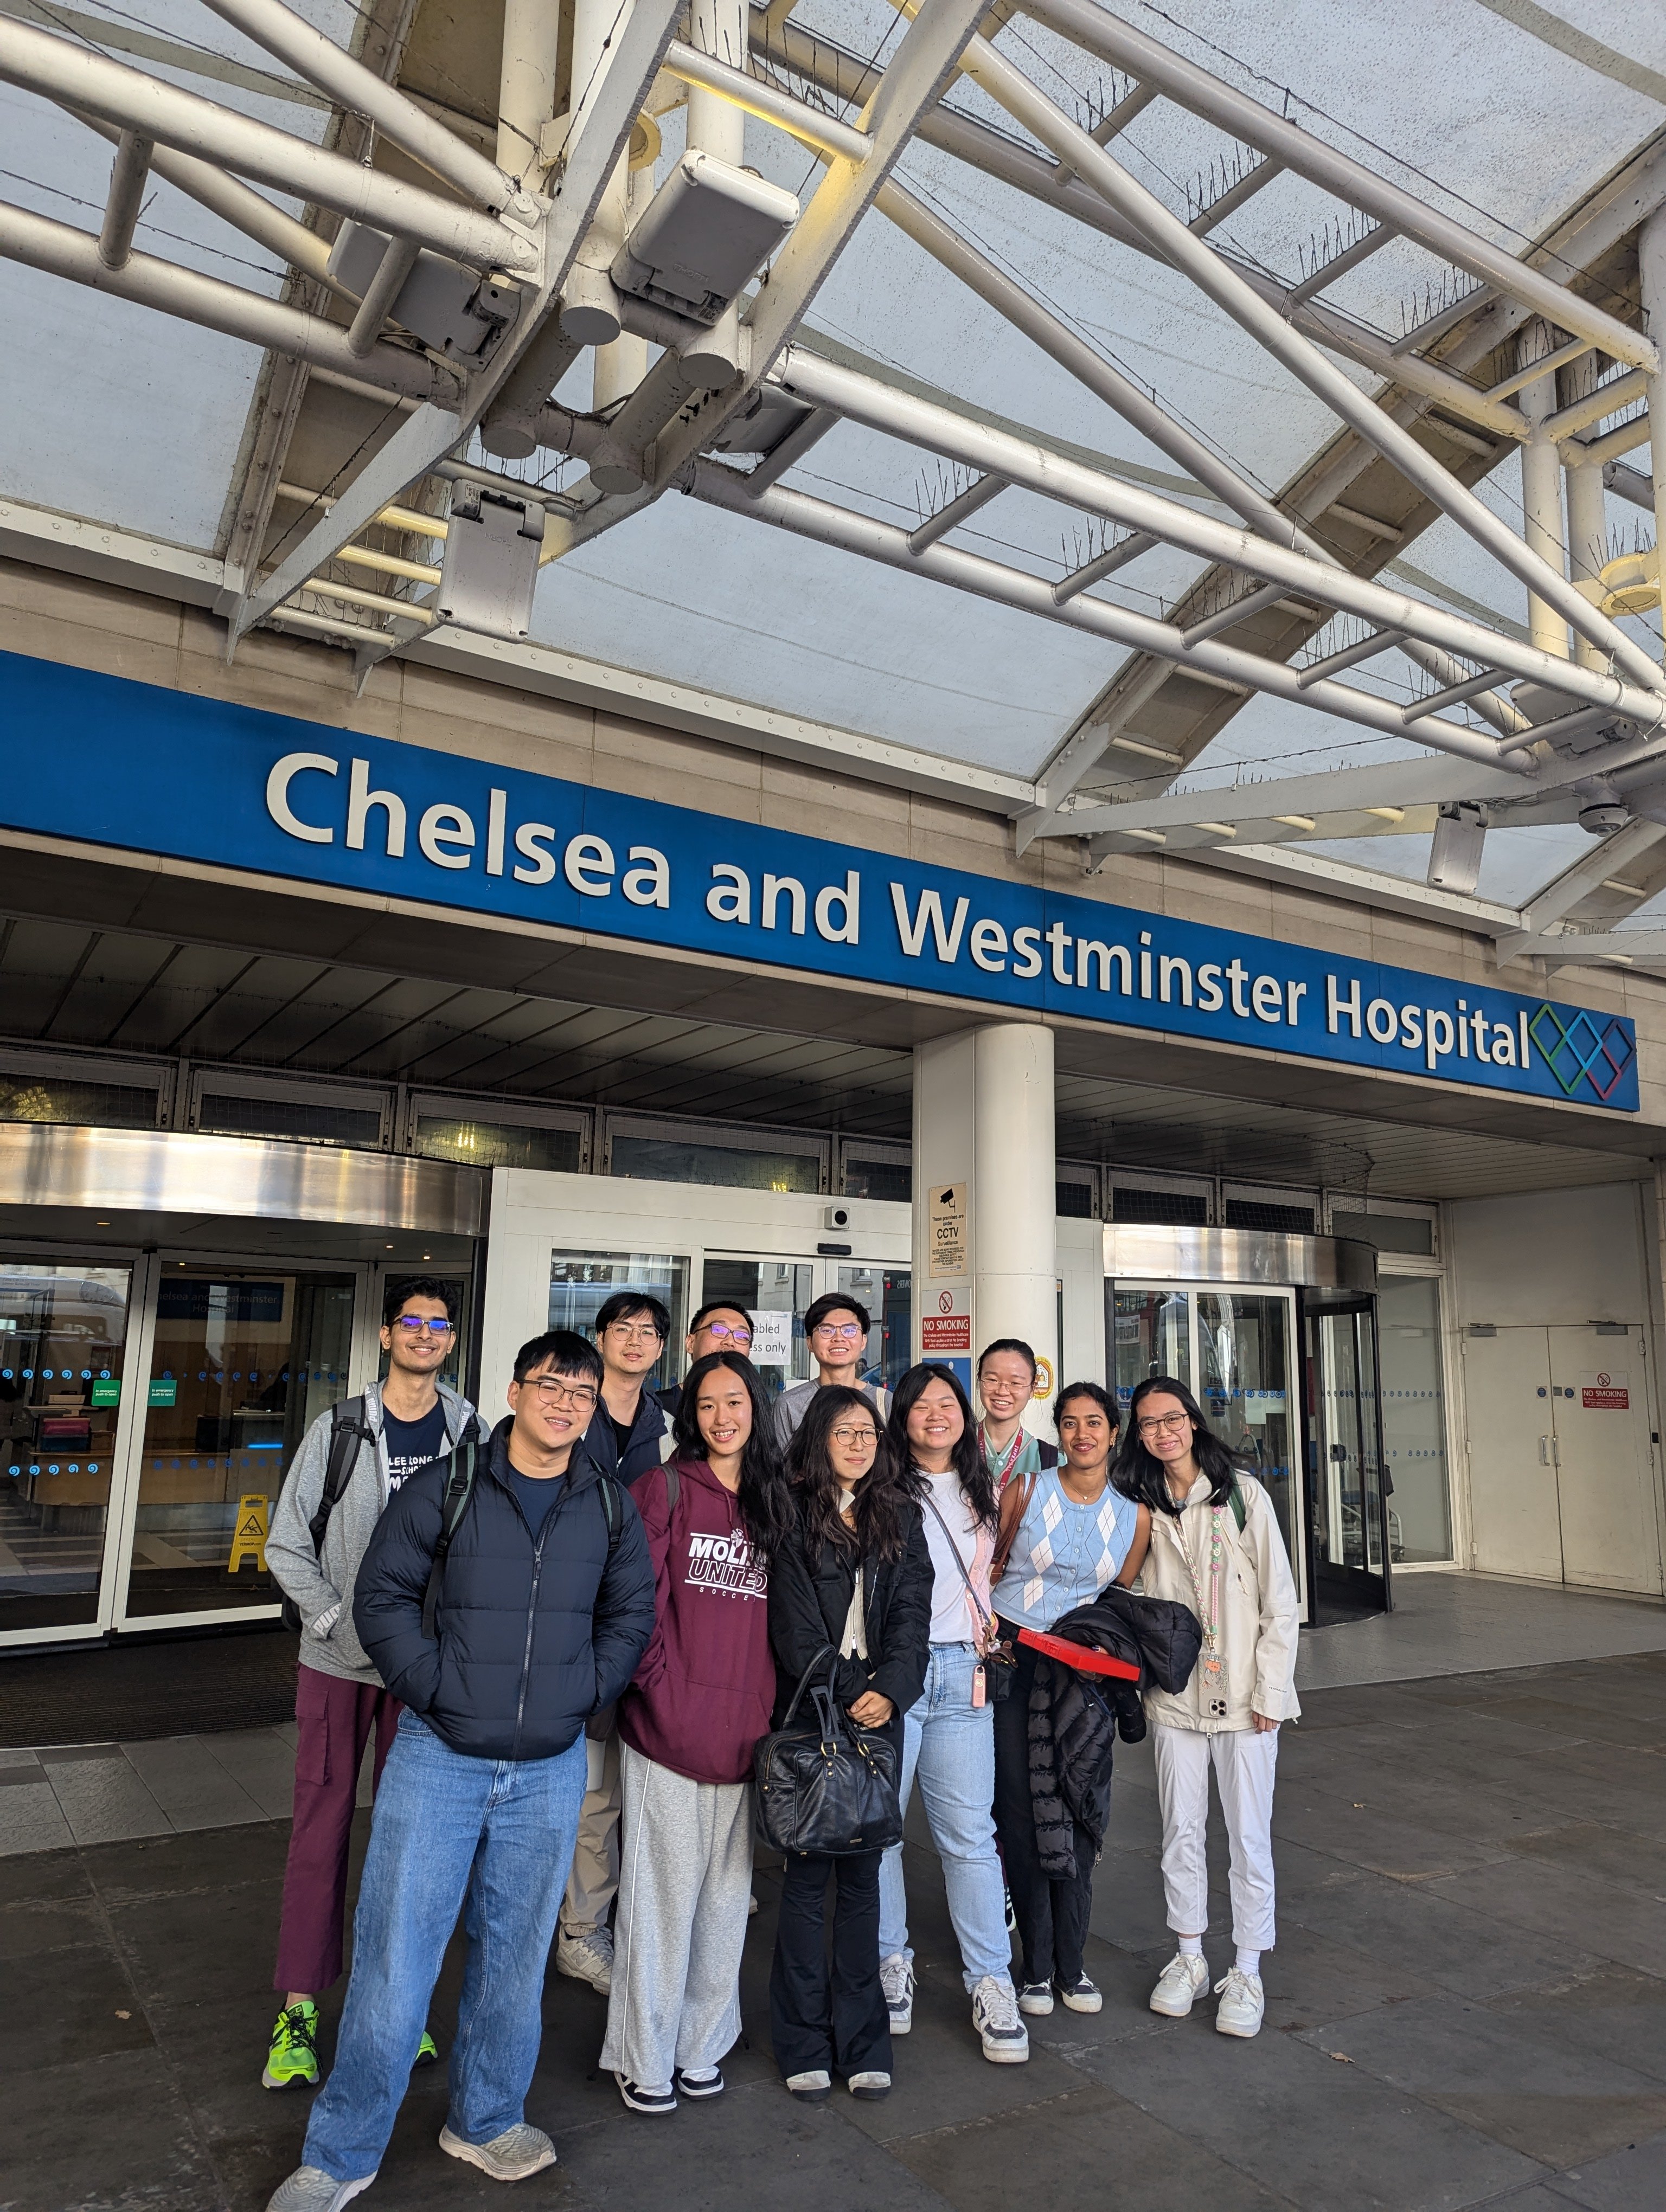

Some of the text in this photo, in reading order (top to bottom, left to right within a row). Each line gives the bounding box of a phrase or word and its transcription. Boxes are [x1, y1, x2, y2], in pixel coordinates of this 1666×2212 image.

[267, 753, 1530, 1070] Chelsea and Westminster Hospital
[937, 1226, 958, 1239] CCTV
[158, 1291, 188, 1301] elsea
[753, 1323, 780, 1334] abled
[924, 1319, 969, 1330] NO SMOKING
[765, 1342, 786, 1355] only
[367, 1398, 377, 1422] PUMA
[389, 1455, 433, 1466] LEE KONG
[401, 1465, 421, 1475] SCH
[689, 1538, 767, 1571] MOL
[689, 1559, 767, 1592] UNITED
[699, 1586, 755, 1603] SOCCE
